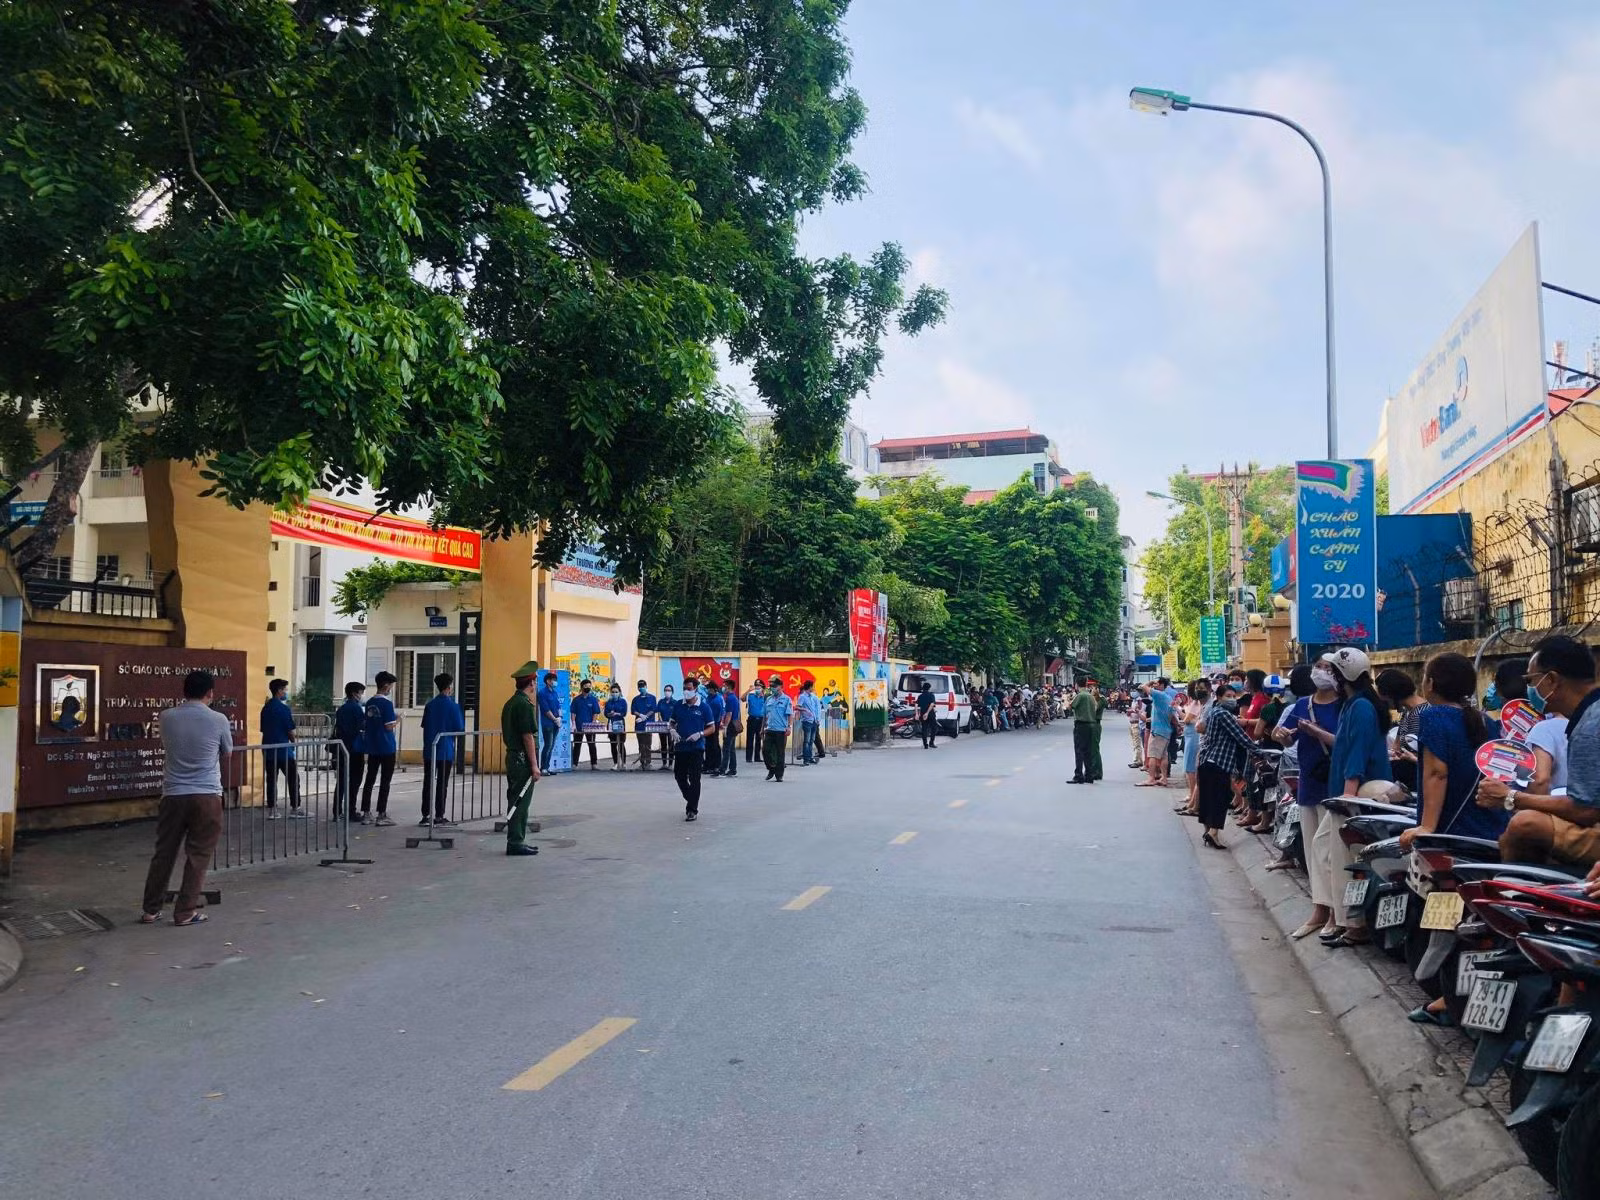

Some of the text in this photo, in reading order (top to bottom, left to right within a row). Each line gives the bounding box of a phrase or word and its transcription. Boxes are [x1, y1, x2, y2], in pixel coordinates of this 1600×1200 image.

[450, 535, 461, 557] QUẢ
[462, 541, 475, 559] CAO
[1311, 583, 1366, 599] 2020
[132, 663, 152, 675] GIÁO
[1476, 981, 1510, 1005] 29-K1
[1466, 1003, 1506, 1029] 128.42
